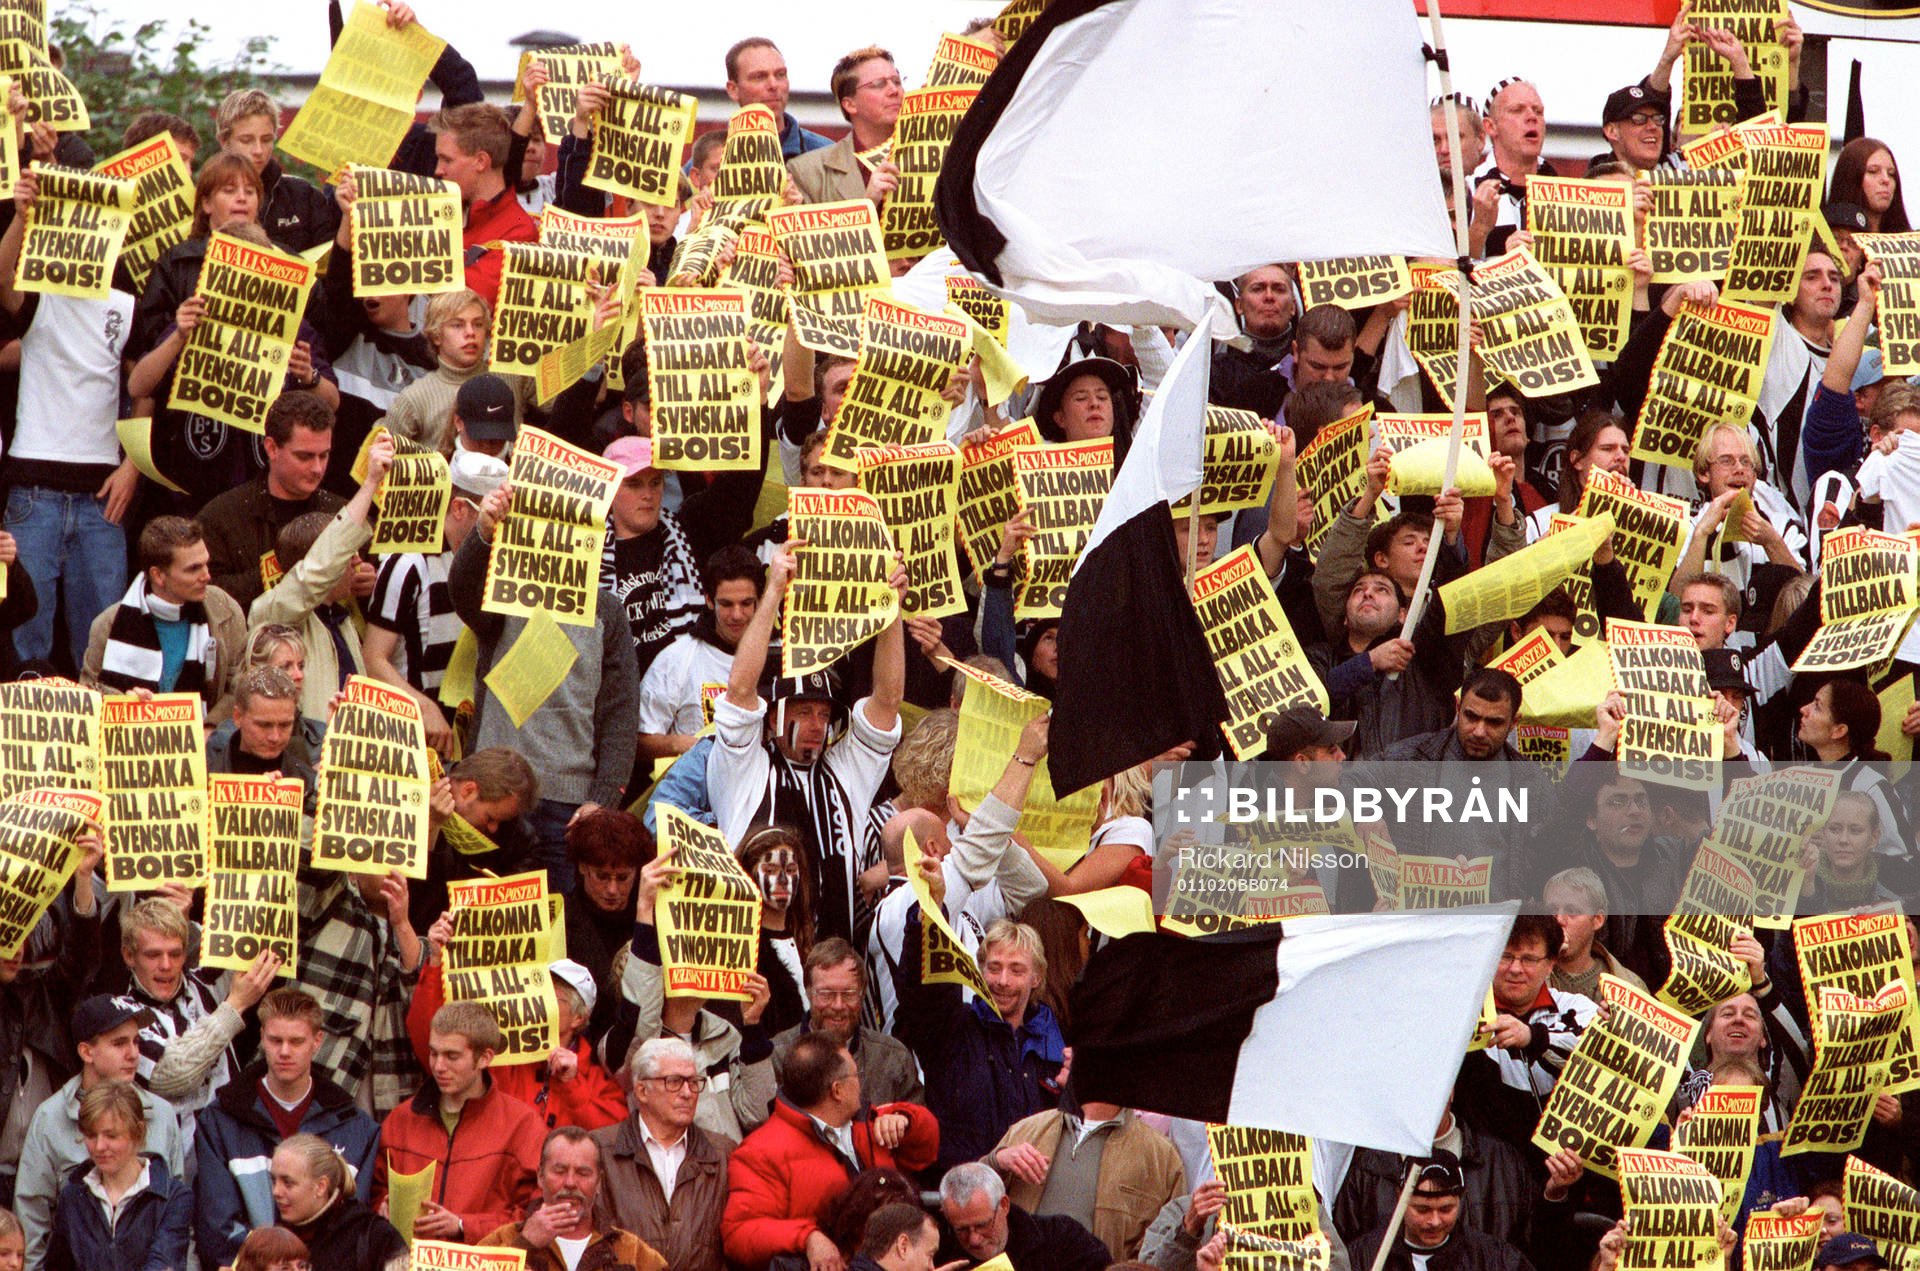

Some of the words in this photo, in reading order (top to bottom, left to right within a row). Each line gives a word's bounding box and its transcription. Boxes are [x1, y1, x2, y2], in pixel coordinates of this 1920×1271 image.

[631, 106, 668, 135] ALL-
[599, 130, 671, 169] SVENSKAN
[593, 156, 667, 194] BOIS!
[1751, 150, 1819, 180] VÄLKOMNA
[356, 172, 447, 196] TILLBAKA
[1746, 180, 1811, 209] TILLBAKA
[34, 202, 67, 228] TILL
[69, 205, 107, 232] ALL-
[357, 202, 393, 228] TILL
[400, 198, 439, 226] ALL-
[1650, 191, 1683, 216] TILL
[1689, 191, 1727, 217] ALL-
[278, 216, 299, 226] FILA
[1535, 206, 1625, 235] VÄLKOMNA
[1742, 211, 1770, 237] TILL
[1773, 212, 1798, 238] ALL-
[28, 230, 109, 262] SVENSKAN
[359, 230, 450, 260] SVENSKAN
[780, 230, 876, 262] VÄLKOMNA
[1533, 236, 1622, 265] TILLBAKA
[1733, 240, 1801, 267] SVENSKAN
[22, 259, 105, 288] BOIS!
[206, 262, 298, 313] VÄLKOMNA
[361, 260, 452, 285] BOIS!
[1728, 269, 1791, 291] BOIS!
[504, 279, 537, 306] TILL
[542, 284, 582, 312] ALL-
[1309, 272, 1399, 304] BOIS!
[1882, 284, 1915, 309] TILL
[954, 300, 1003, 316] RONA
[1516, 308, 1554, 337] ALL-
[499, 312, 587, 342] SVENSKAN
[651, 314, 745, 340] VÄLKOMNA
[1675, 314, 1762, 366] VÄLKOMNA
[230, 332, 268, 360] ALL-
[652, 342, 746, 370] TILLBAKA
[868, 322, 961, 364] VÄLKOMNA
[1485, 331, 1574, 371] SVENSKAN
[182, 348, 272, 397] SVENSKAN
[864, 348, 950, 392] TILLBAKA
[1664, 344, 1750, 394] TILLBAKA
[177, 378, 266, 423] BOIS!
[655, 373, 691, 400] TILL
[699, 373, 738, 400] ALL-
[853, 376, 884, 409] TILL
[888, 386, 928, 418] ALL-
[1657, 372, 1690, 403] TILL
[1695, 391, 1732, 416] ALL-
[657, 406, 748, 433] SVENSKAN
[839, 405, 931, 445] SVENSKAN
[659, 437, 749, 460] BOIS!
[411, 458, 438, 484] ALL-
[512, 455, 606, 498] VÄLKOMNA
[864, 462, 953, 492] VÄLKOMNA
[383, 489, 442, 518] SVENSKAN
[376, 520, 436, 543] BOIS!
[501, 517, 538, 547] TILL
[541, 522, 581, 552] ALL-
[495, 548, 588, 588] SVENSKAN
[798, 552, 887, 582] TILLBAKA
[1826, 552, 1908, 588] VÄLKOMNA
[492, 581, 585, 616] BOIS!
[793, 585, 831, 612] TILL
[834, 586, 876, 614] ALL-
[1195, 576, 1269, 631] LKOMNA
[1826, 581, 1906, 620] TILLBAKA
[790, 616, 886, 645] SVENSKAN
[1814, 624, 1894, 653] SVENSKAN
[1240, 644, 1281, 680] ALL-
[1803, 642, 1885, 667] BOIS!
[2, 685, 94, 716] VÄLKOMNA
[1621, 673, 1709, 698] TILLBAKA
[1626, 694, 1659, 719] TILL
[1667, 702, 1703, 725] ALL-
[2, 714, 89, 746] TILLBAKA
[105, 725, 196, 755] VÄLKOMNA
[334, 705, 418, 749] VÄLKOMNA
[1626, 719, 1711, 758] SVENSKAN
[2, 744, 38, 771] TILL
[44, 748, 82, 773] ALL-
[329, 738, 418, 779] TILLBAKA
[1626, 750, 1714, 783] BOIS!
[105, 759, 193, 789] TILLBAKA
[326, 772, 362, 801] TILL
[368, 780, 408, 805] ALL-
[108, 794, 142, 820] TILL
[148, 793, 186, 820] ALL-
[322, 804, 416, 841] SVENSKAN
[109, 823, 199, 854] SVENSKAN
[320, 835, 416, 867] BOIS!
[112, 855, 203, 880] BOIS!
[213, 874, 247, 899] TILL
[209, 905, 293, 938] SVENSKAN
[451, 904, 542, 936] VÄLKOMNA
[671, 902, 753, 935] TILLBAKA
[448, 938, 537, 968] TILLBAKA
[668, 935, 751, 969] VÄLKOMNA
[1804, 932, 1903, 977] VÄLKOMNA
[448, 970, 486, 1000] TILL
[492, 968, 529, 996] ALL-
[1579, 1027, 1666, 1094] TILLBAKA
[1823, 1039, 1888, 1069] TILLBAKA
[1565, 1055, 1598, 1093] TILL
[1604, 1077, 1641, 1114] ALL-
[1809, 1070, 1838, 1096] TILL
[1840, 1066, 1871, 1089] ALL-
[1551, 1085, 1639, 1148] SVENSKAN
[1800, 1093, 1873, 1124] SVENSKAN
[1788, 1120, 1860, 1145] BOIS!
[1219, 1157, 1303, 1191] TILLBAKA
[1627, 1177, 1718, 1205] VÄLKOMNA
[1226, 1195, 1258, 1224] TILL
[1266, 1191, 1298, 1220] ALL-
[1629, 1209, 1714, 1237] TILLBAKA
[1622, 1241, 1657, 1268] TILL
[1662, 1242, 1702, 1268] ALL-
